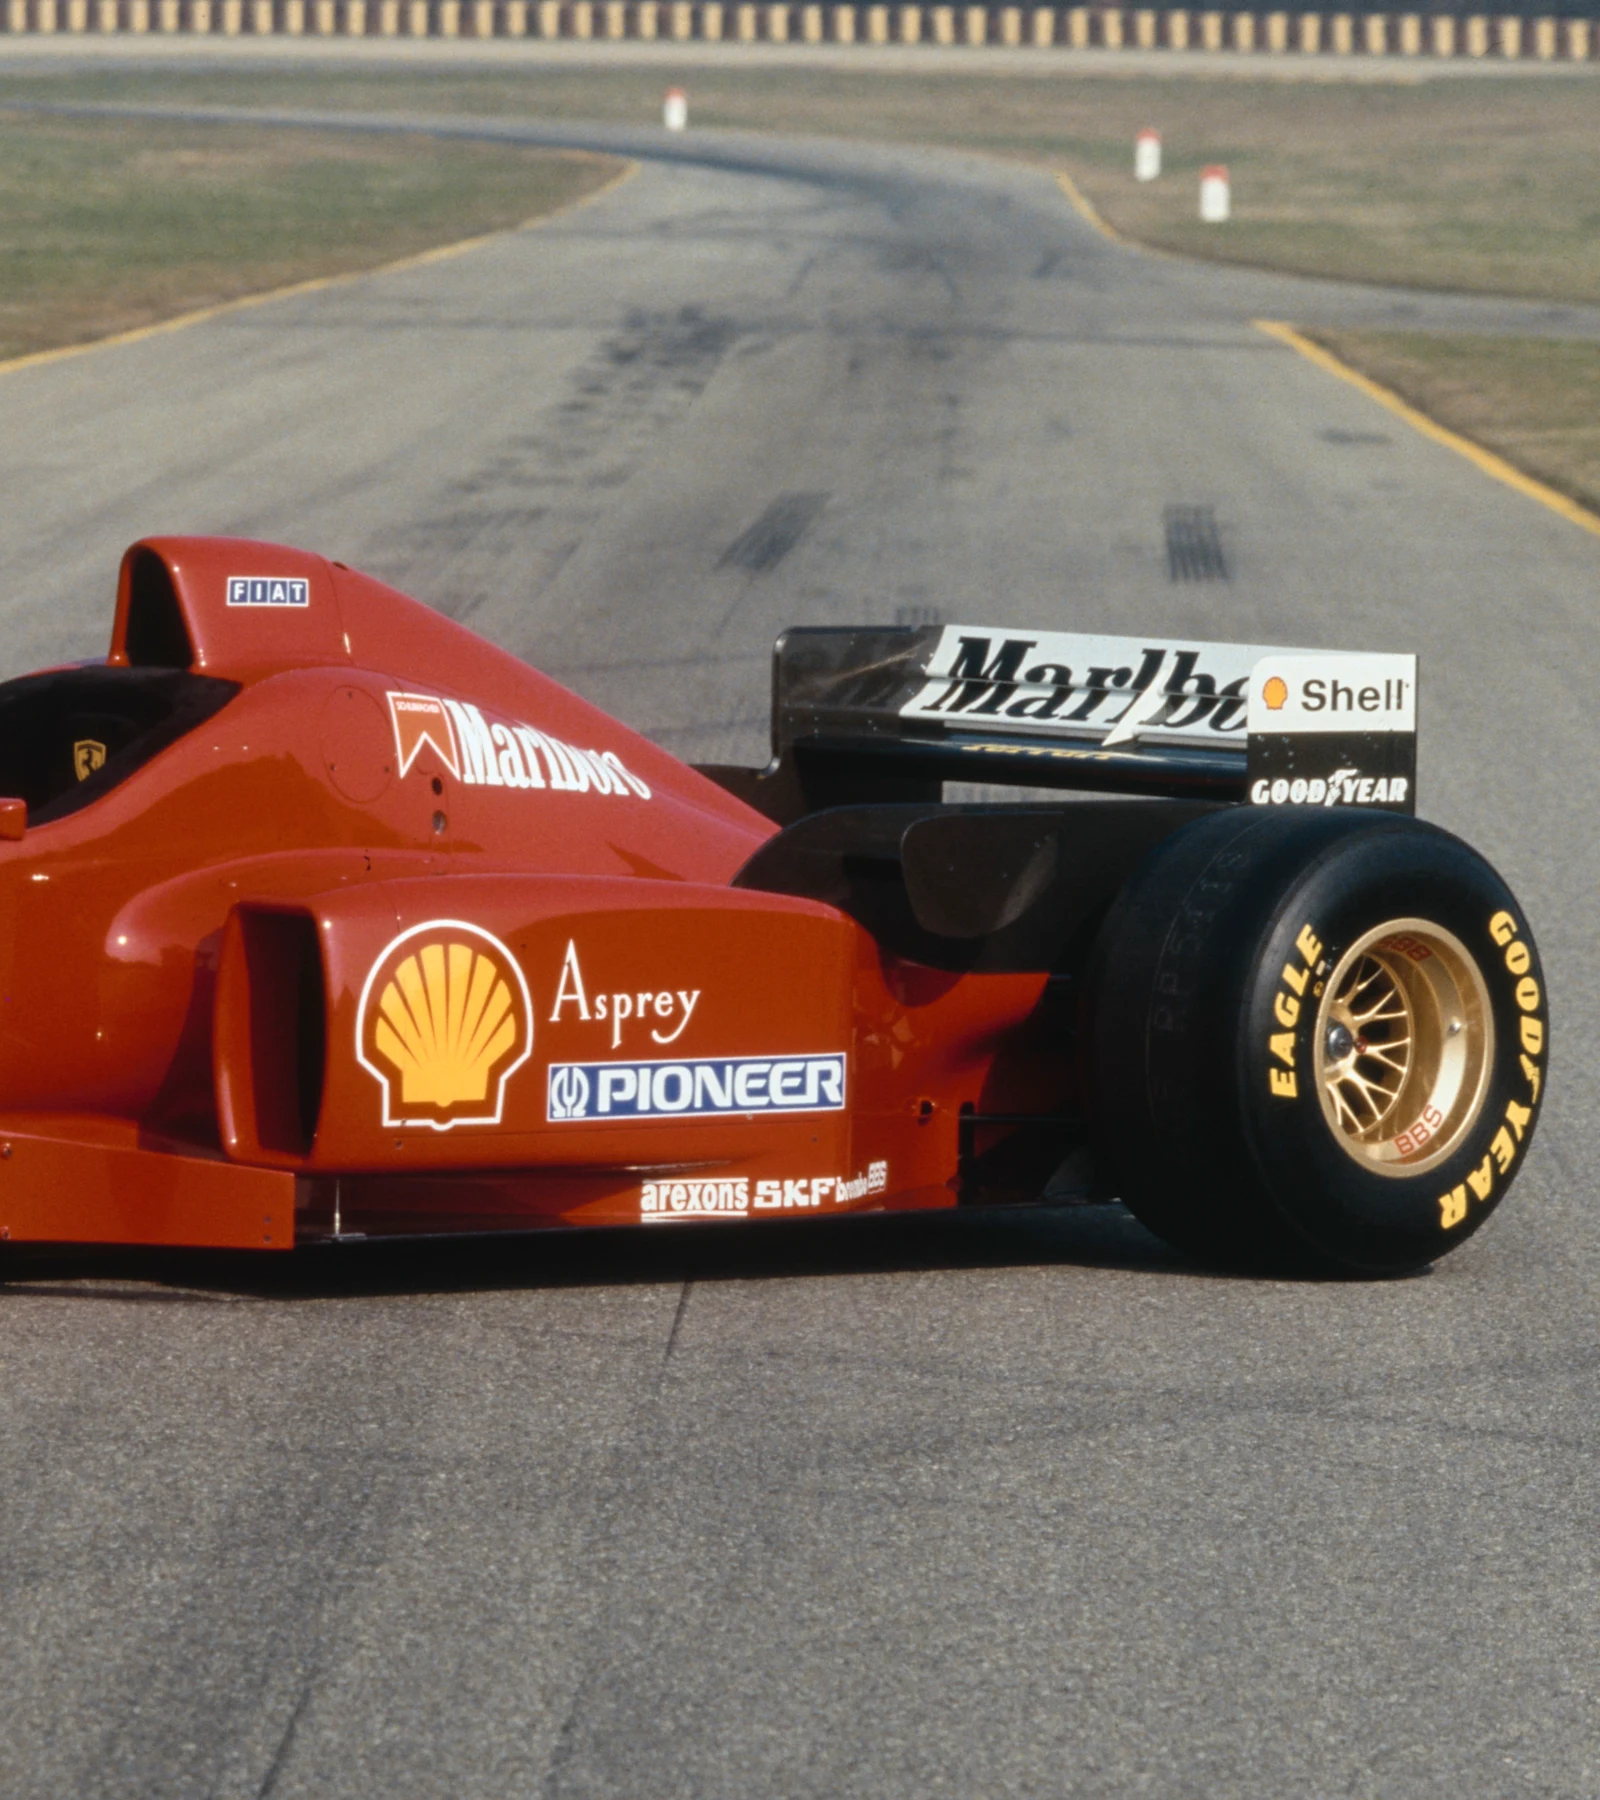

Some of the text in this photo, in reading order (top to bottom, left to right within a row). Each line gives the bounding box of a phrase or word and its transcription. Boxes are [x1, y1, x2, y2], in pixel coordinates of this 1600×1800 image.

[231, 581, 305, 603] FIAT
[1301, 679, 1403, 712] Shell
[443, 698, 652, 800] Marlboro
[1251, 770, 1409, 806] GOODYEAR
[549, 939, 701, 1050] Asprey
[1269, 924, 1324, 1099] EAGLE
[597, 1059, 844, 1113] PIONEER
[1393, 1104, 1443, 1157] BBS
[640, 1182, 749, 1212] arexons
[753, 1177, 835, 1209] SKF
